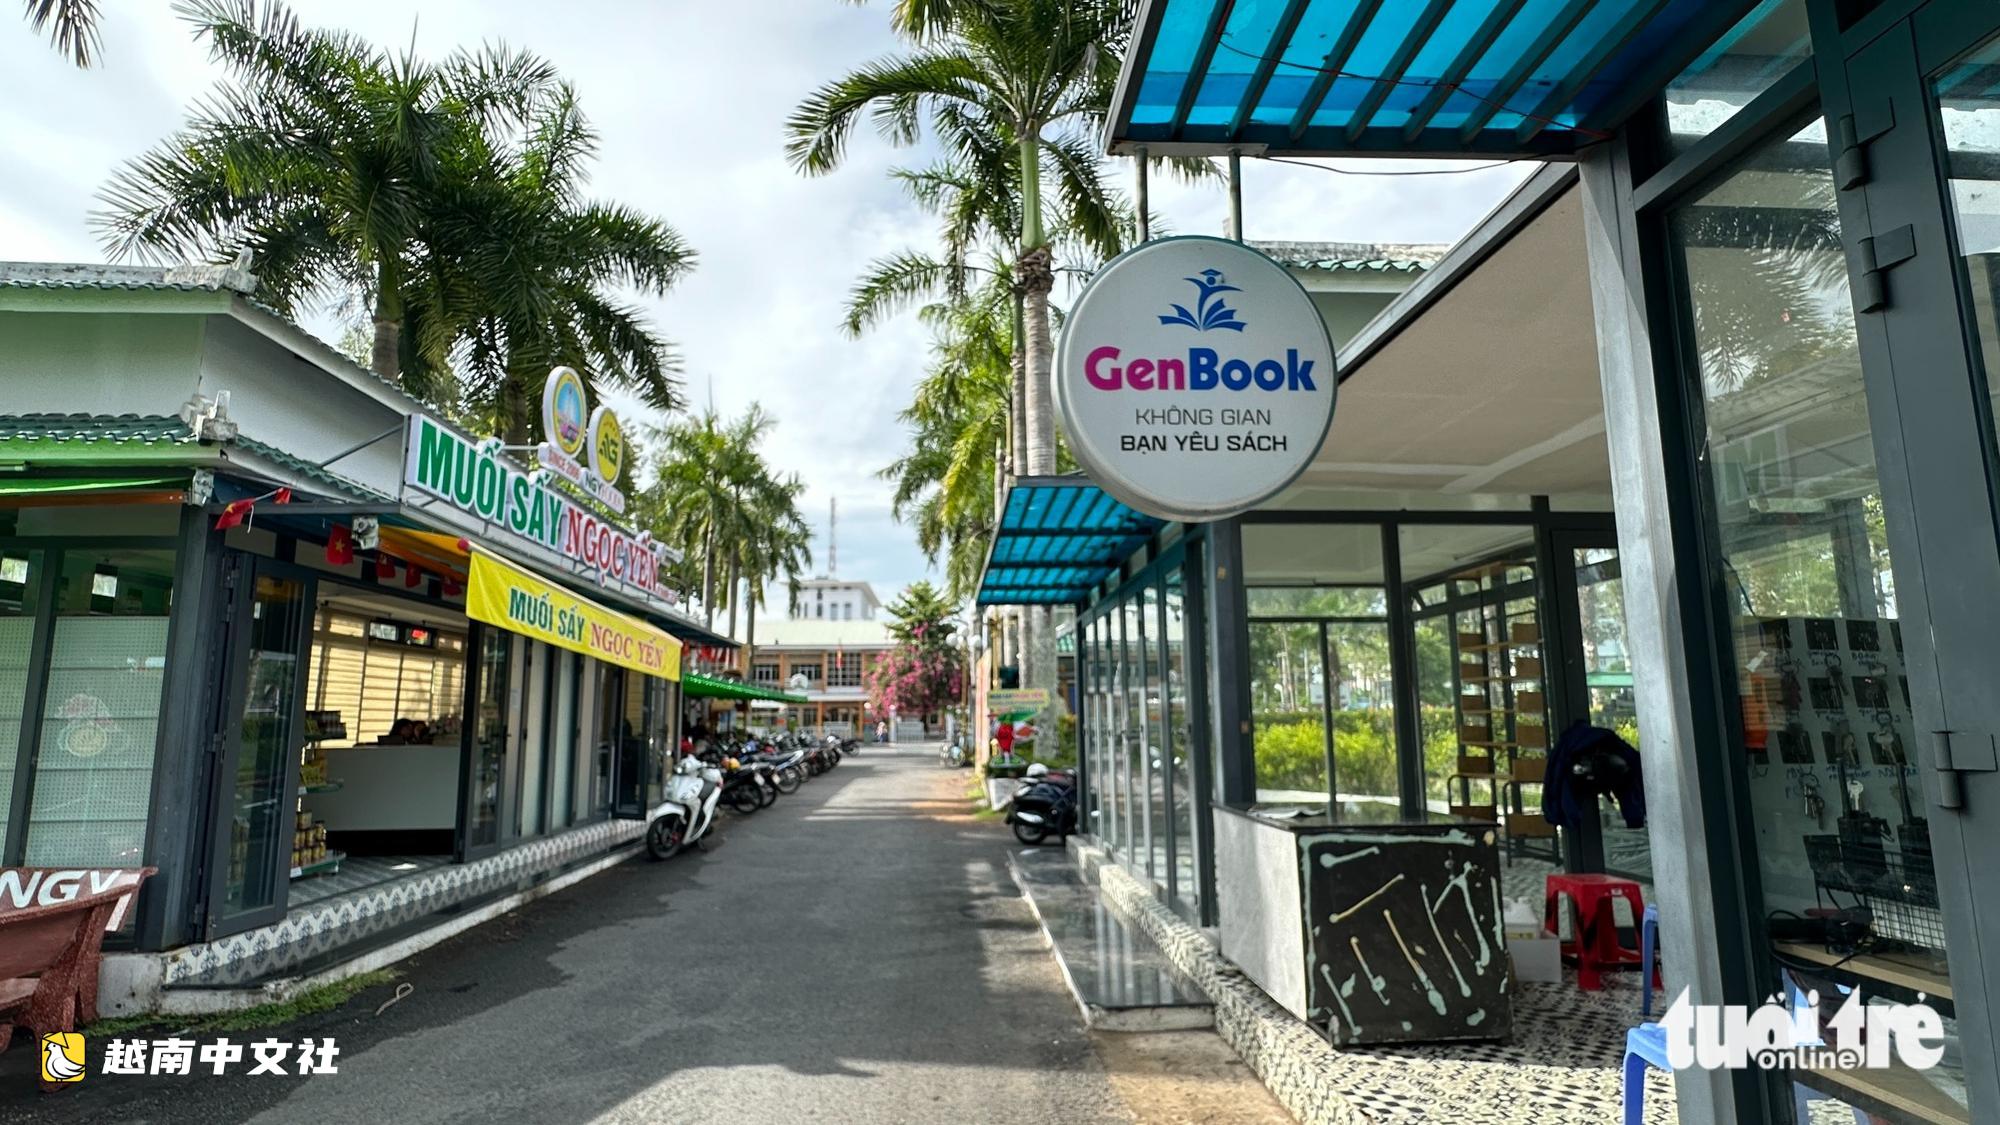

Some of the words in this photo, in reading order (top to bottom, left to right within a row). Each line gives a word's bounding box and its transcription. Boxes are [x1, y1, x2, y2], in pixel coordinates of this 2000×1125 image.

[1084, 346, 1318, 391] GenBook
[1136, 405, 1213, 426] KHÔNG
[1221, 408, 1271, 426] GIAN
[1121, 435, 1167, 454] BẠN
[1174, 431, 1219, 451] YÊU
[1227, 431, 1287, 451] SÁCH
[417, 420, 508, 522] MUỐI
[510, 473, 562, 546] SẤY
[566, 507, 625, 584] NGỌC
[628, 533, 657, 592] YẾN
[509, 588, 554, 632] MUỐI
[558, 604, 586, 642] SẤY
[591, 622, 634, 661] NGỌC
[638, 637, 664, 668] YẾN
